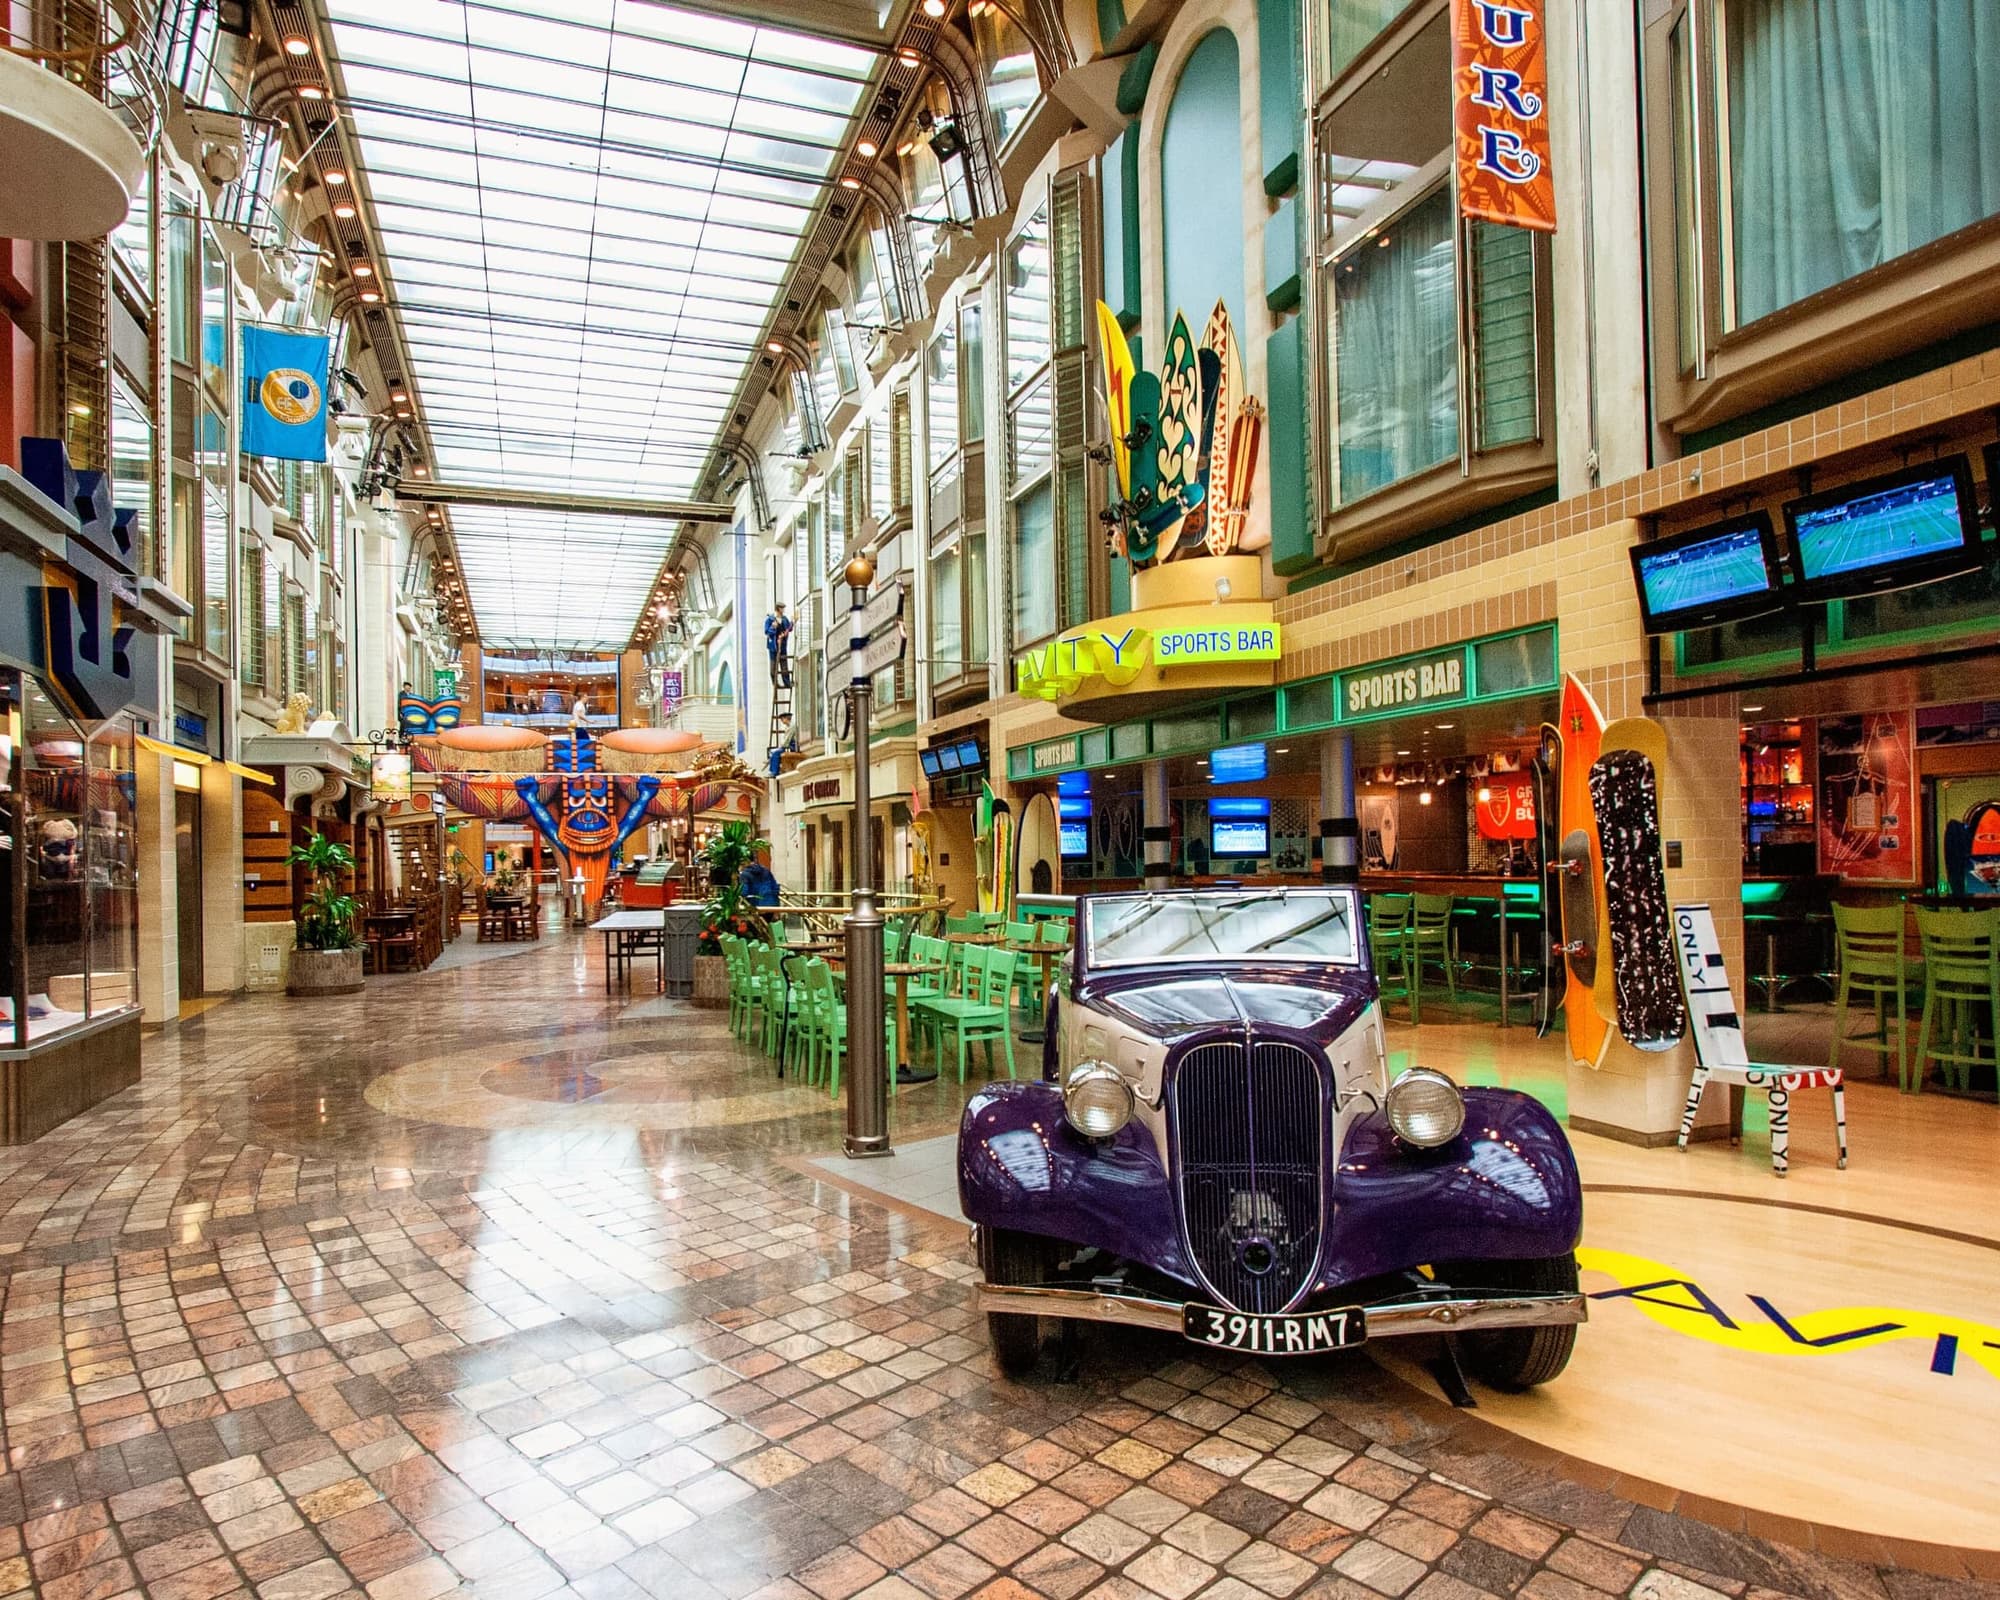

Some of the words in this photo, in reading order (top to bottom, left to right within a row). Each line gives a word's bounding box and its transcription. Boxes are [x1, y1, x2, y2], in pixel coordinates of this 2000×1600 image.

[1470, 0, 1542, 184] URE
[1160, 631, 1231, 656] SPORTS
[1237, 629, 1275, 651] BAR
[1348, 667, 1418, 712] SPORTS
[1420, 659, 1462, 699] BAR
[1034, 744, 1061, 769] SPORTS
[1061, 741, 1076, 763] BAR
[1678, 914, 1706, 985] ONLY
[1768, 1089, 1789, 1161] ONLY
[1205, 1310, 1349, 1353] 3911-RM7
